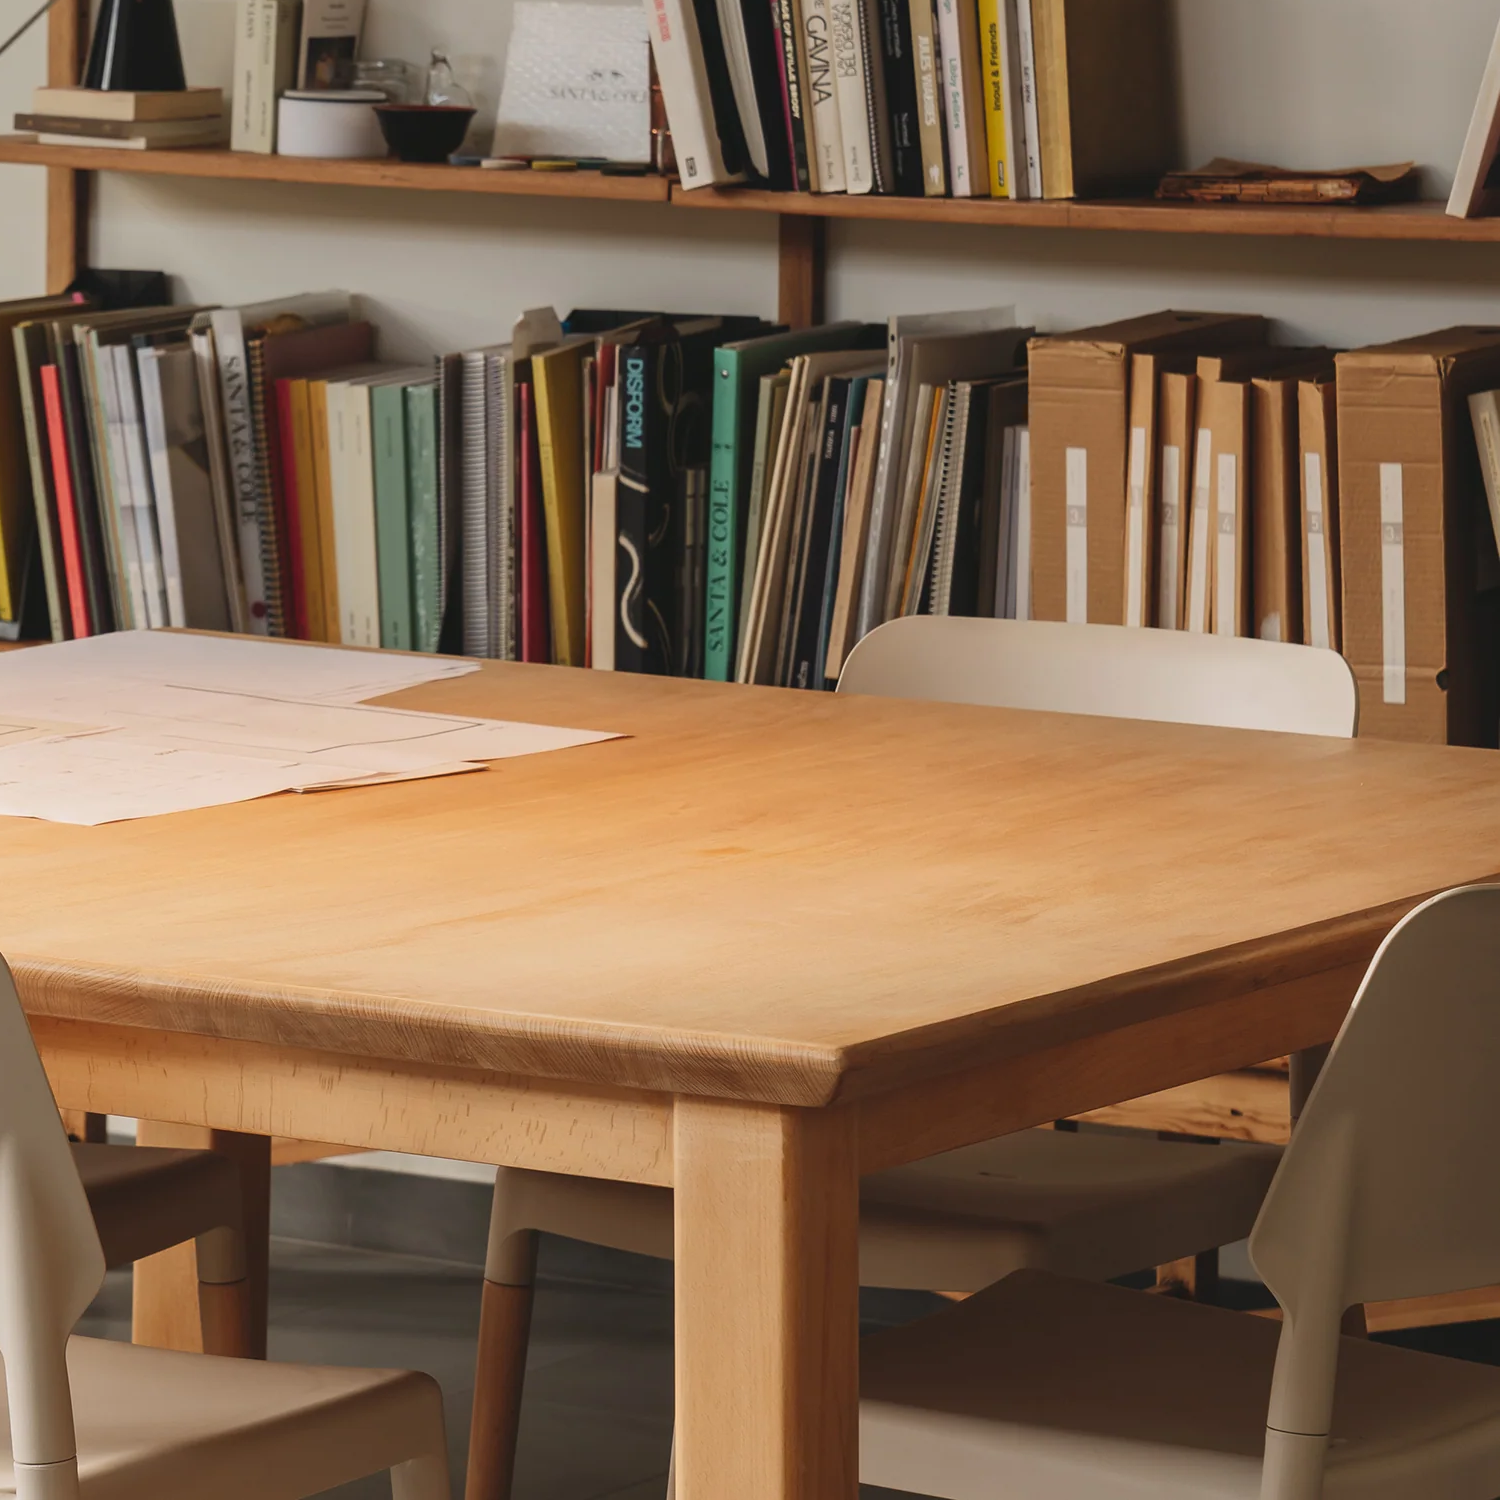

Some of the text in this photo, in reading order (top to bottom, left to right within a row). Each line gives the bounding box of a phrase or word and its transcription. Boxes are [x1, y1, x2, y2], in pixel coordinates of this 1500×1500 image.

[805, 15, 832, 106] GAVINA
[844, 53, 857, 77] DEL
[918, 36, 933, 73] JULES
[988, 22, 999, 66] Friends
[782, 22, 792, 37] OF
[788, 84, 800, 119] BRODY
[948, 58, 959, 88] Libby
[952, 91, 962, 129] Sellers
[991, 81, 1001, 111] Inout
[625, 357, 645, 449] DISFORM
[225, 356, 259, 526] SANTA & COLE
[707, 479, 731, 654] SANTA & COLE
